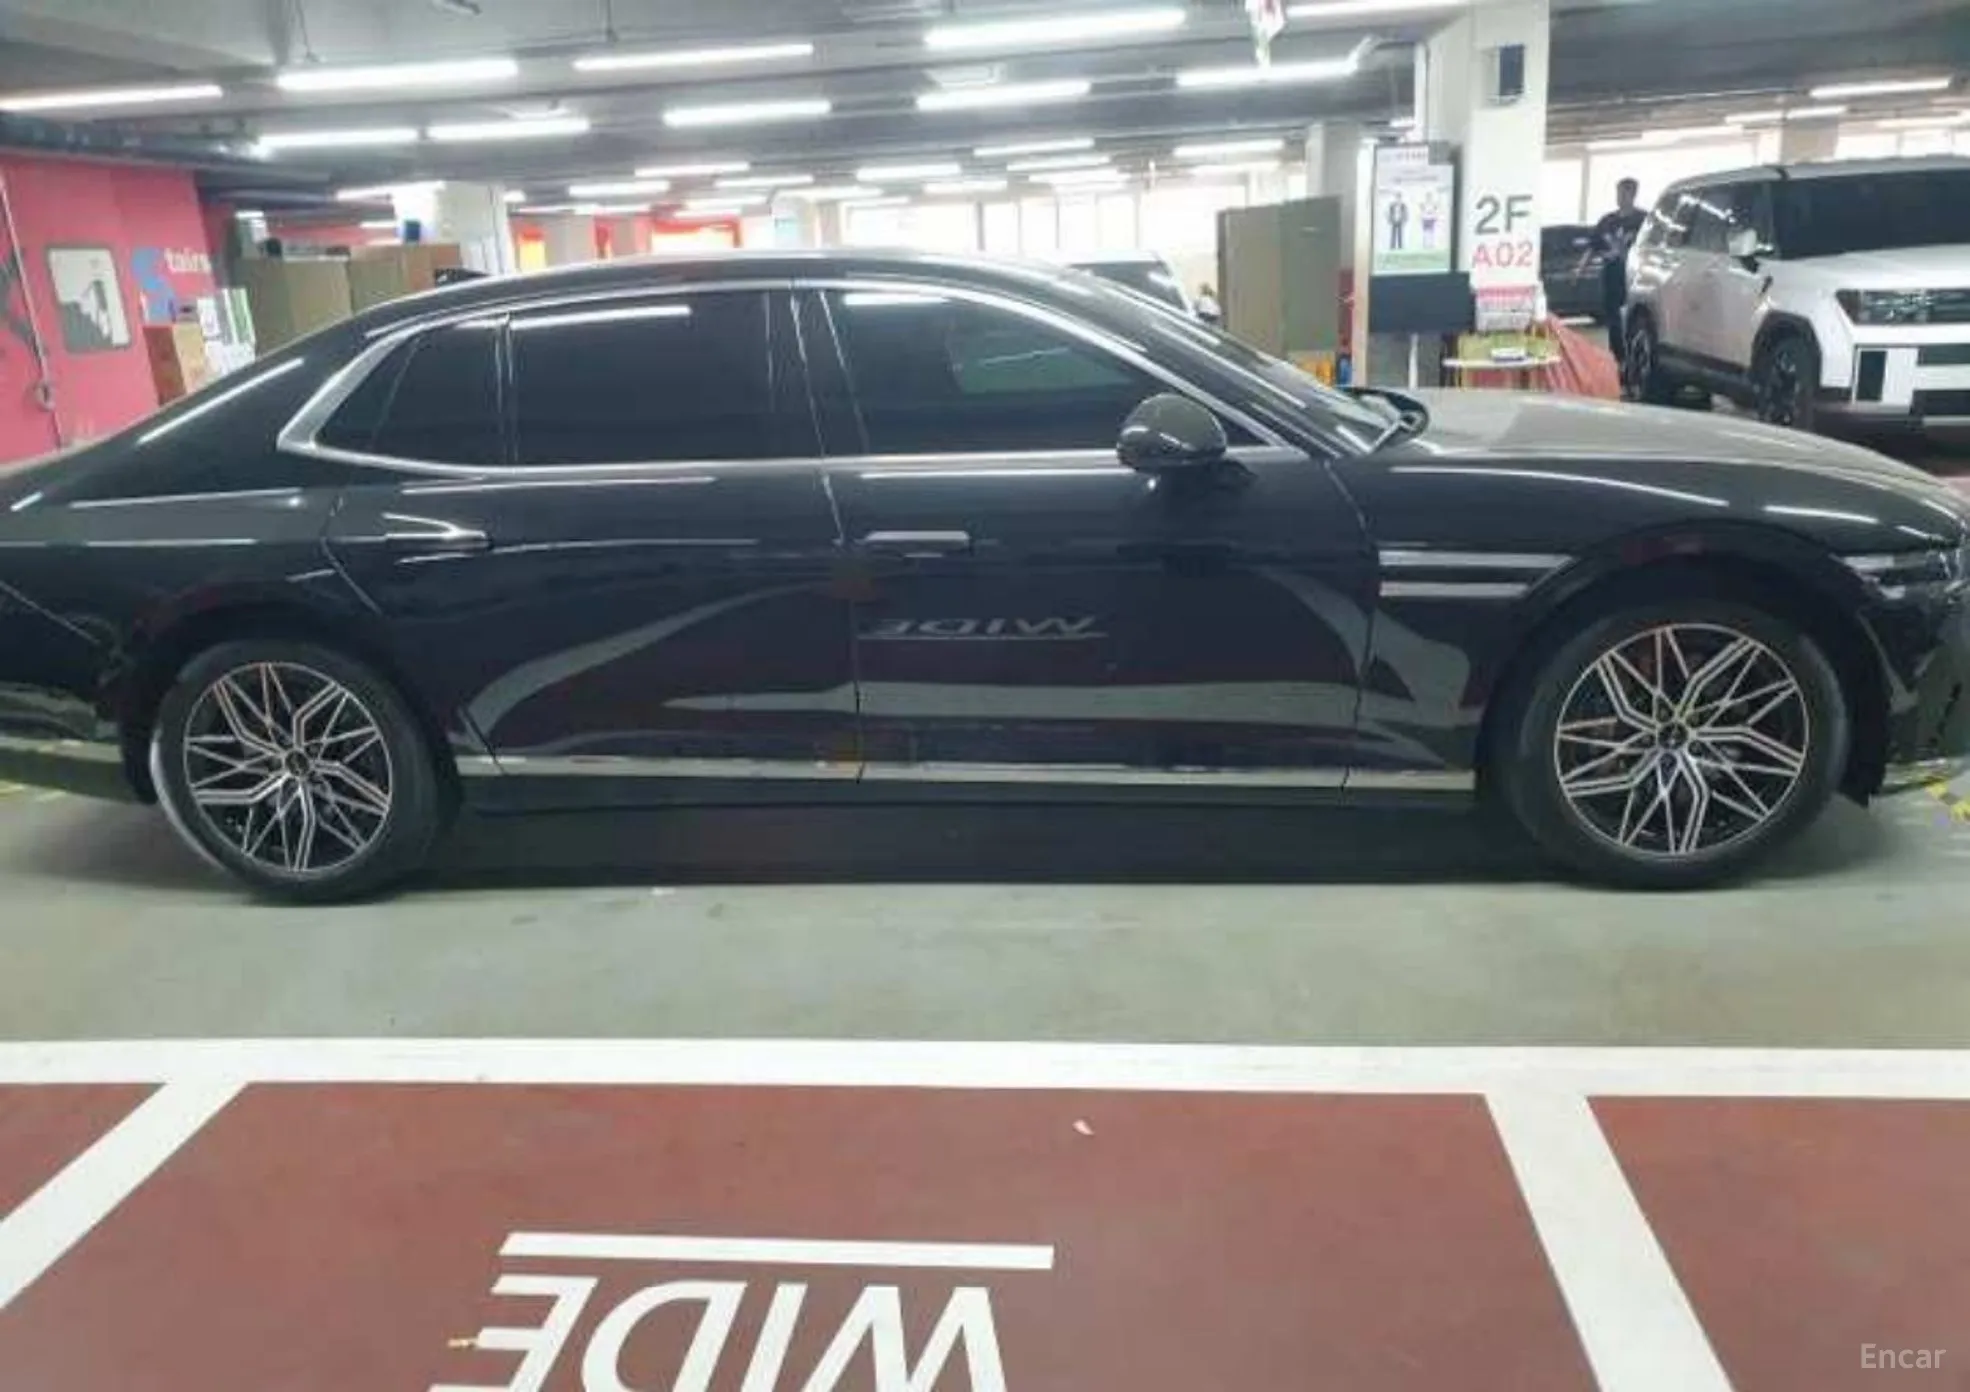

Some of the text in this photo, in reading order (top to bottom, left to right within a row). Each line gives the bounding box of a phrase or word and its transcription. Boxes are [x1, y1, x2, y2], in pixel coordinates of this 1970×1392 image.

[1475, 194, 1533, 235] 2F
[1472, 240, 1533, 268] A02
[427, 1274, 1009, 1392] WIDE
